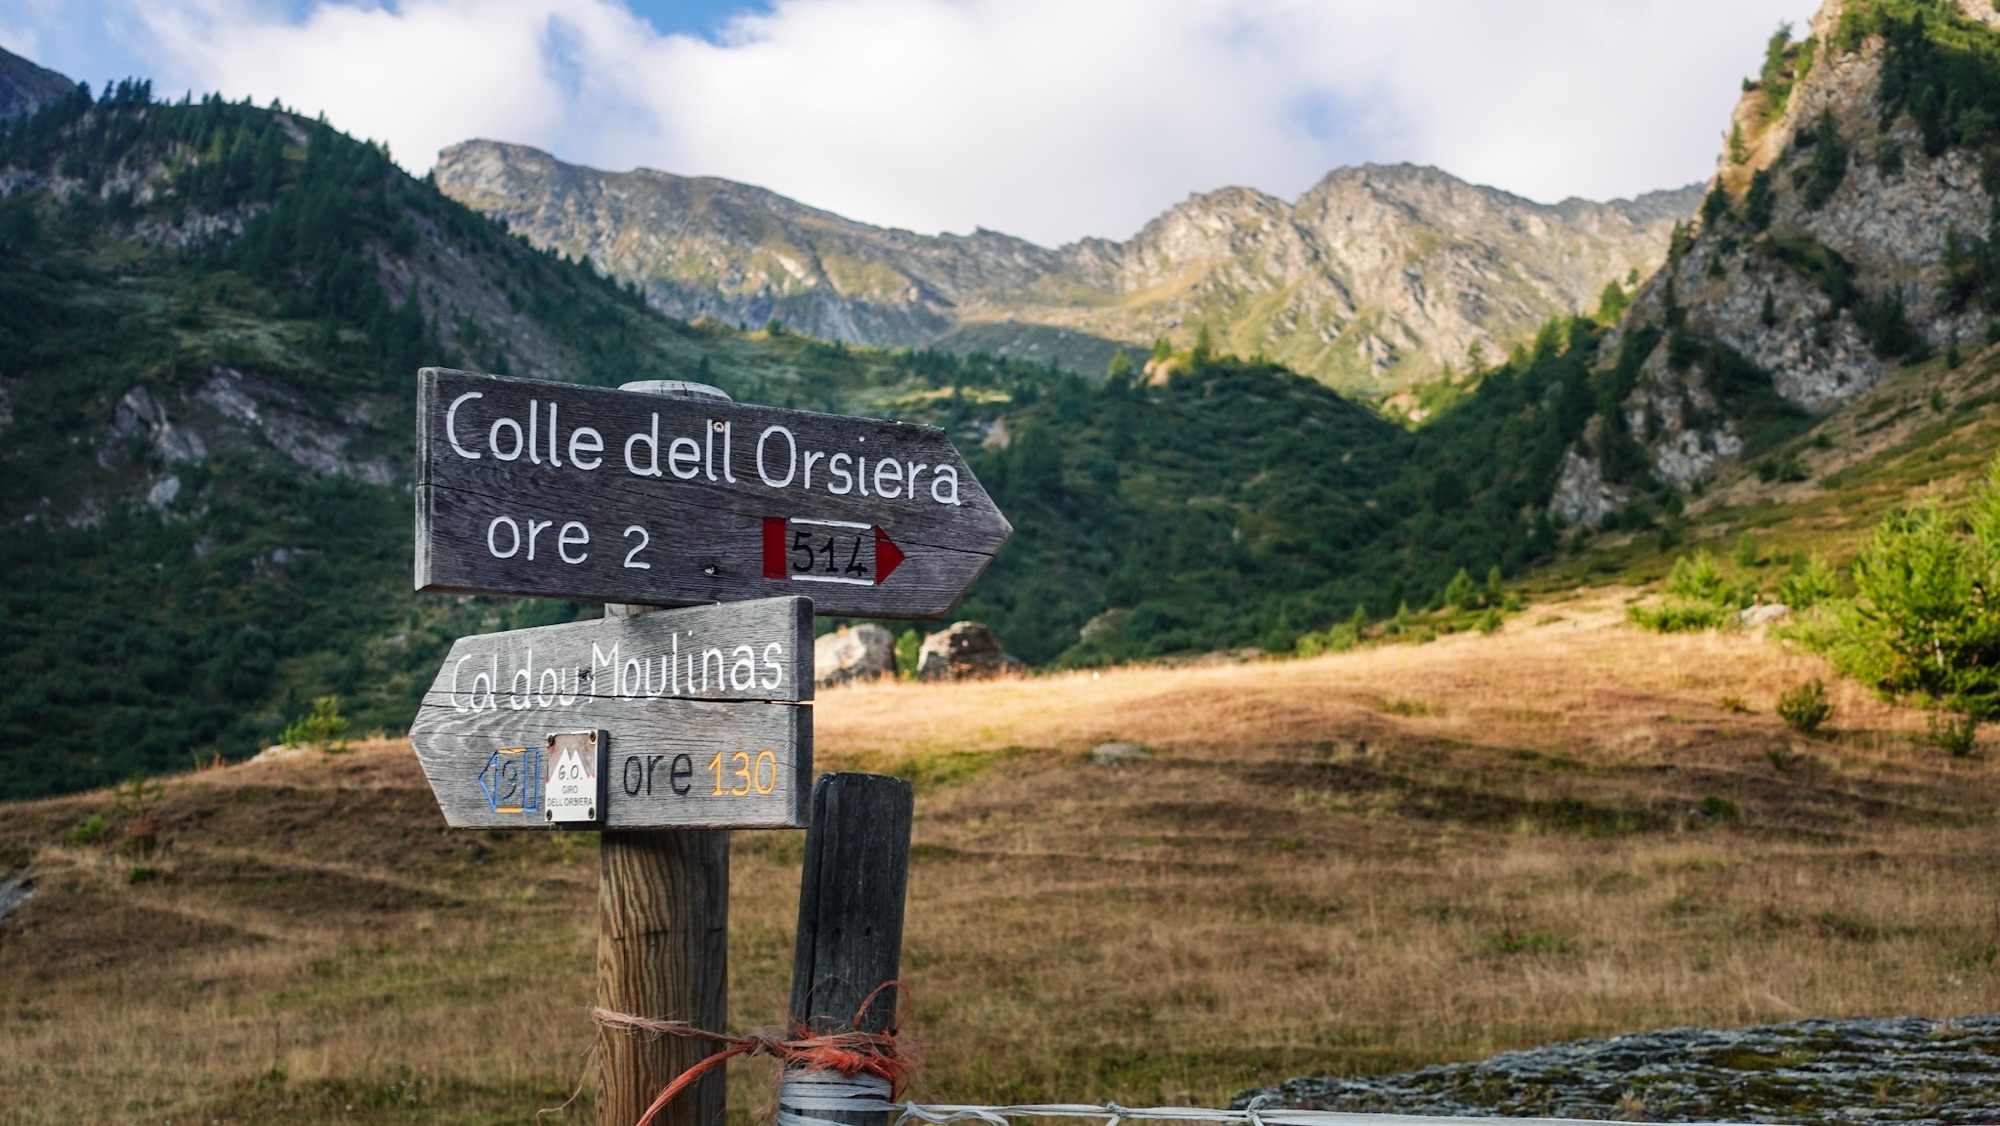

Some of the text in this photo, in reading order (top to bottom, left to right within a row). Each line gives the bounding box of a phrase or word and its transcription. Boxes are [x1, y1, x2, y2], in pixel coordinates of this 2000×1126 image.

[446, 392, 962, 506] Colle dell Orsiera
[487, 516, 651, 570] ore 2
[791, 532, 868, 576] 514
[450, 630, 784, 714] Col dou Moulinas
[502, 760, 519, 802] 9
[558, 764, 583, 781] G.O.
[561, 785, 579, 795] GIRO
[624, 754, 693, 797] ore
